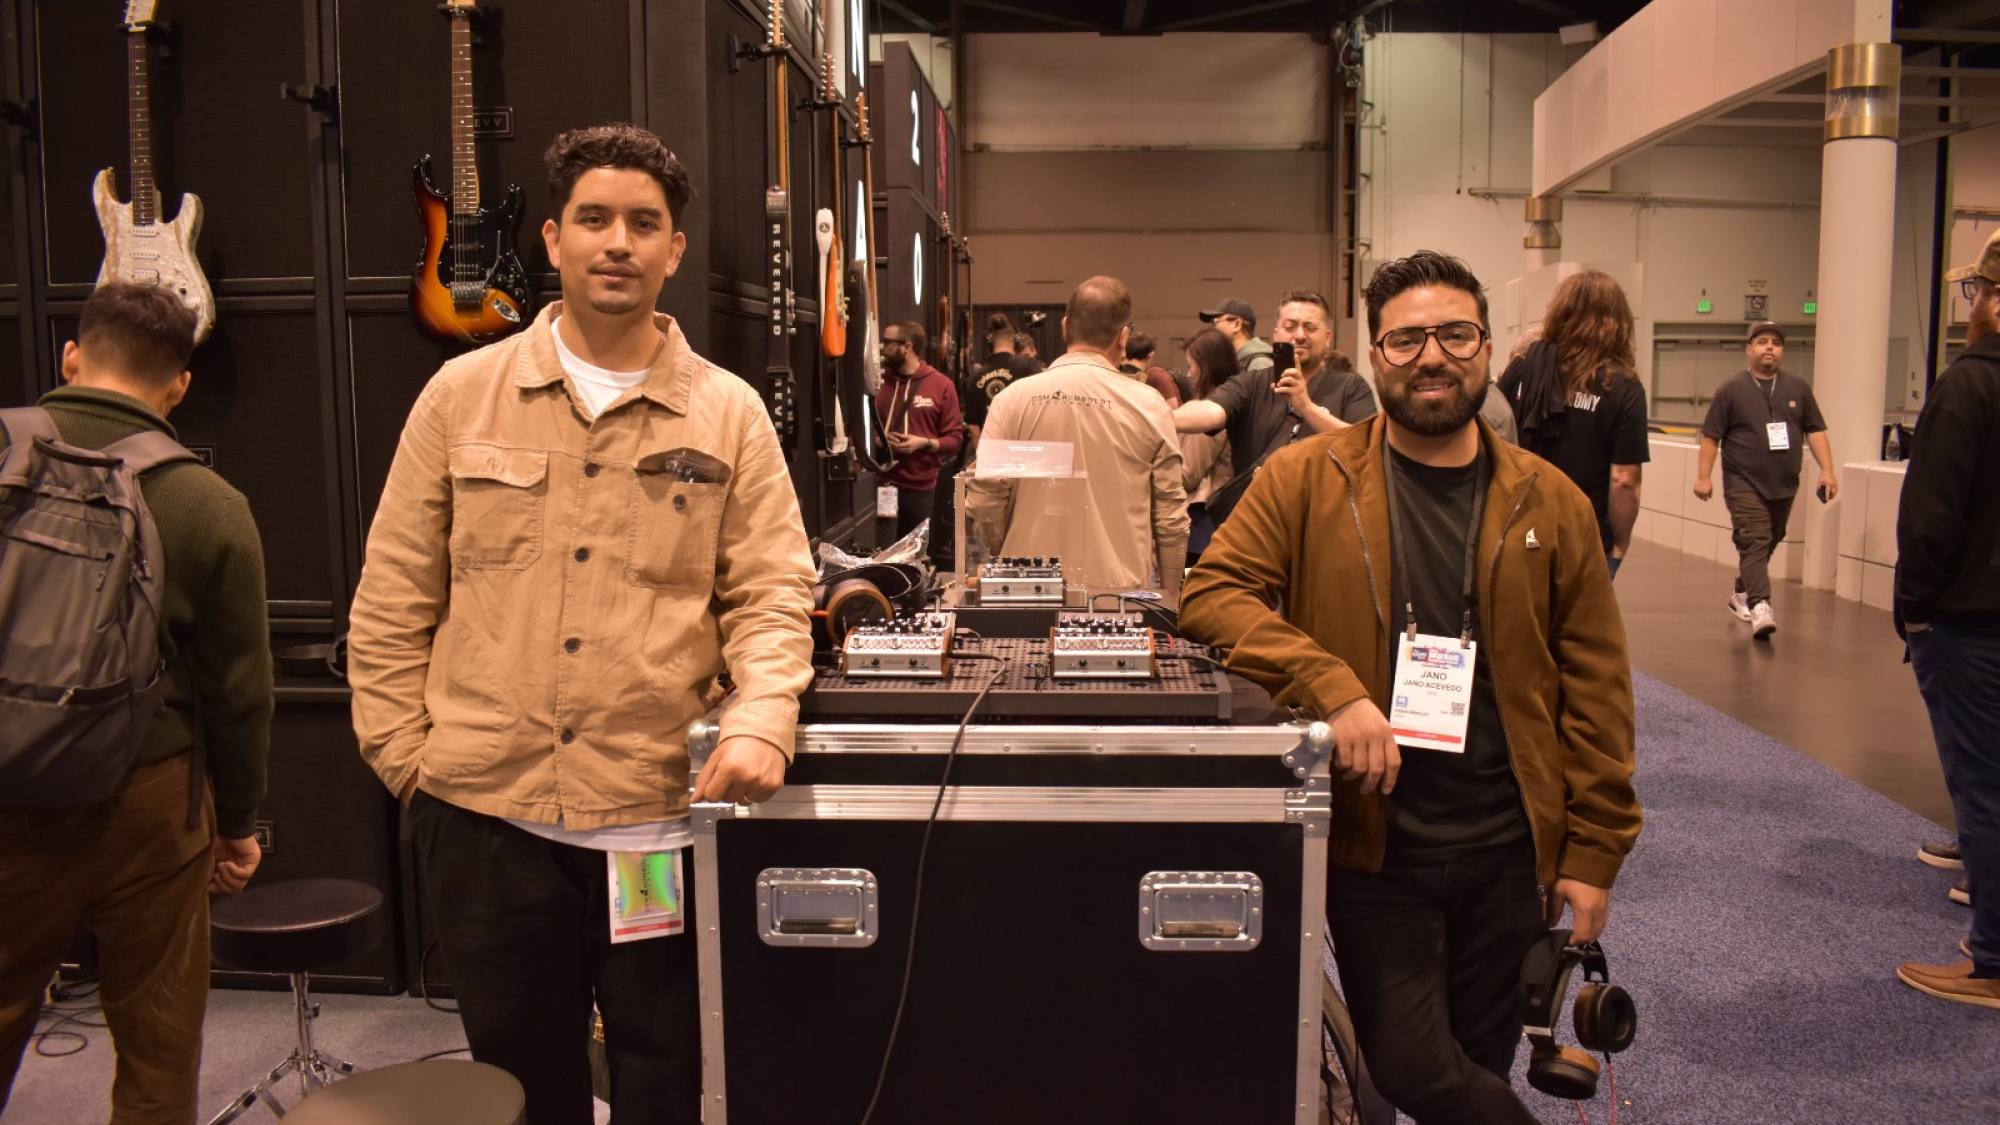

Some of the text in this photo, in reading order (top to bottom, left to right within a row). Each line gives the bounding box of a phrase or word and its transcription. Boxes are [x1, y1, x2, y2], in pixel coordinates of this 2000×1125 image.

[474, 118, 502, 127] EVV
[772, 223, 781, 336] REVEREND
[1573, 391, 1600, 411] OMY
[1420, 671, 1447, 681] JANO
[1403, 680, 1462, 693] JANO ACEVEDO
